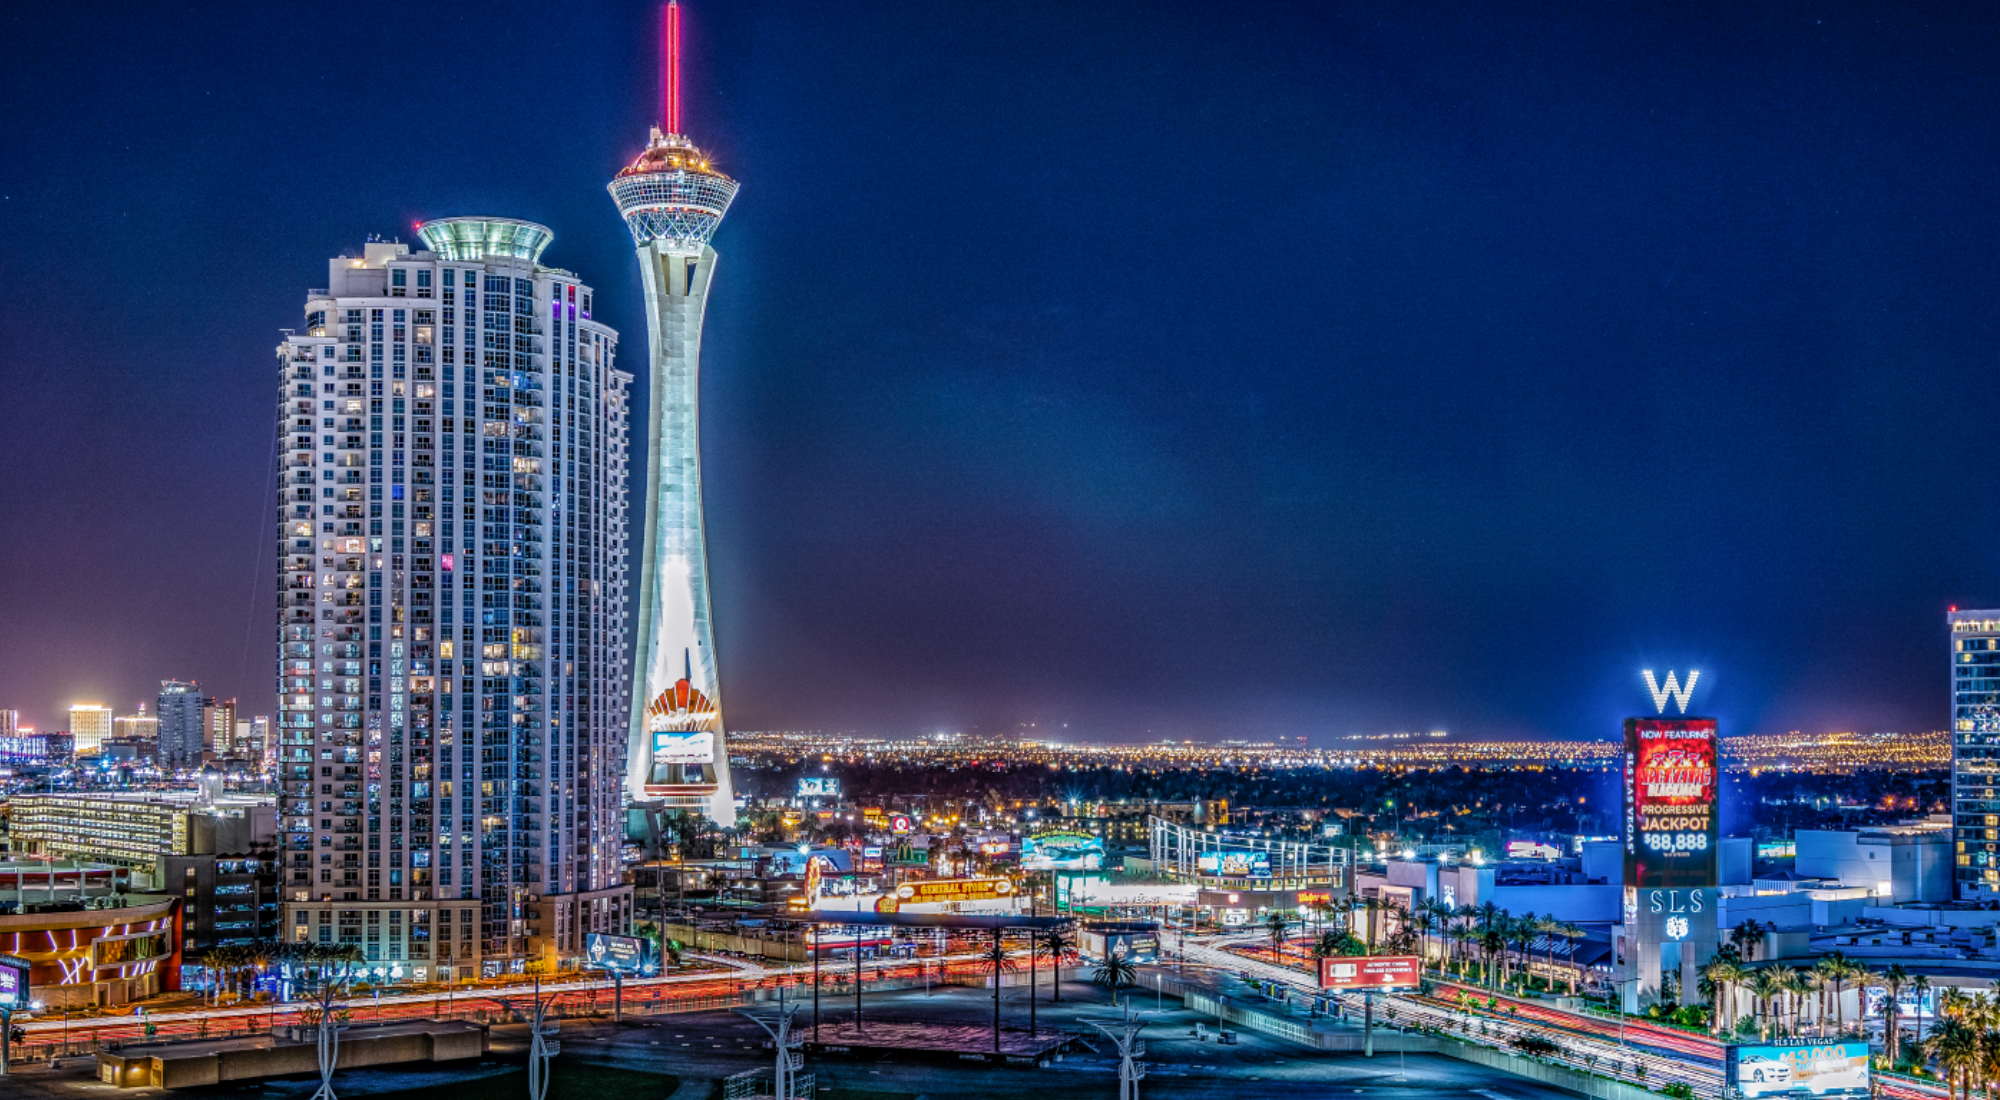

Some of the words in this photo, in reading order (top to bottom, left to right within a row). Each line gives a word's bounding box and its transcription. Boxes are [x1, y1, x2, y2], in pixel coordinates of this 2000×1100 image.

[1642, 669, 1700, 714] W
[1641, 731, 1662, 739] NOW
[1664, 731, 1709, 739] FEATURING
[1626, 753, 1634, 775] SLS
[1626, 777, 1634, 803] LAS
[1647, 785, 1703, 797] BLACKJACK
[1641, 805, 1710, 815] PROGRESSIVE
[1641, 817, 1710, 831] JACKPOT
[1644, 833, 1708, 853] $88,888
[921, 884, 960, 894] GENERAL
[1651, 889, 1704, 913] SLS
[1774, 1039, 1788, 1047] SLS
